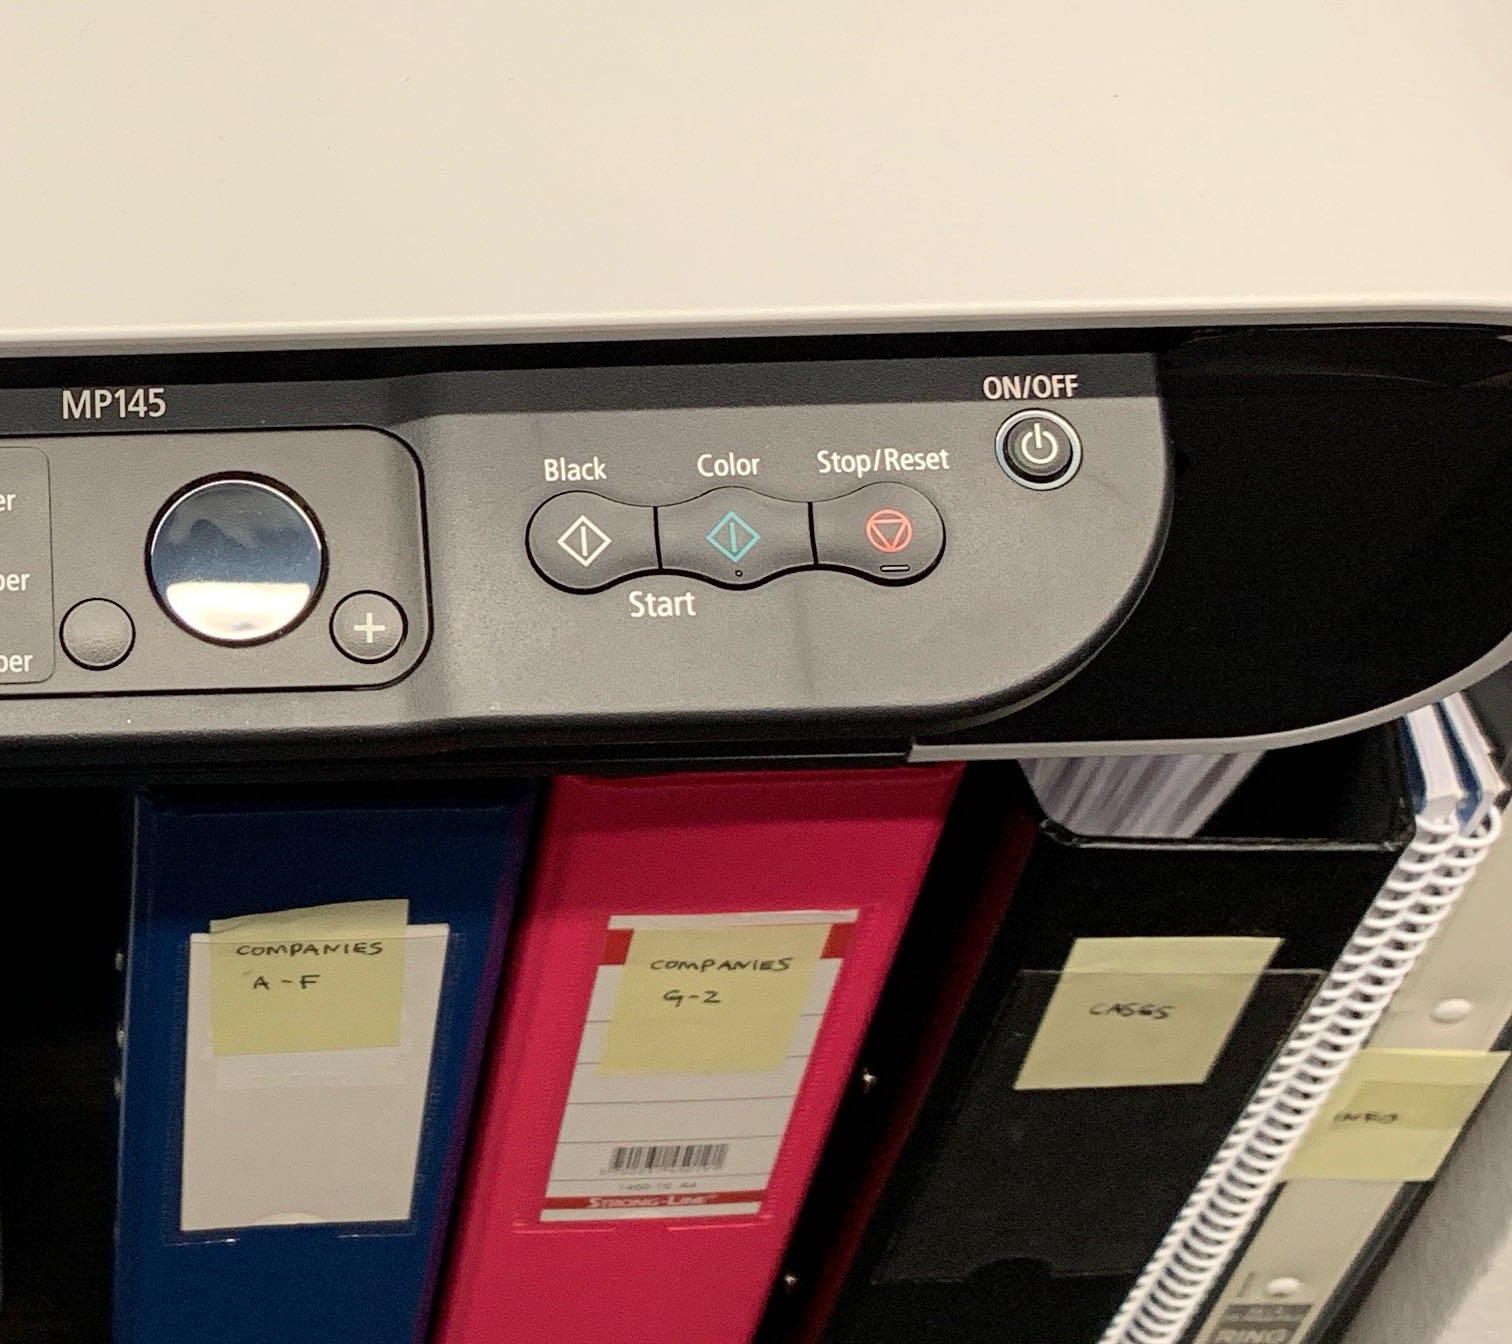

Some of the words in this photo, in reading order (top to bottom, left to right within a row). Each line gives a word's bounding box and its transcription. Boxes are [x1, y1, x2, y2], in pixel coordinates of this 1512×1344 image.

[982, 375, 1079, 400] ON/OFF
[62, 387, 167, 420] MP145
[544, 457, 607, 481] Black
[697, 453, 761, 477] Color
[816, 448, 950, 474] Stop/Reset
[628, 591, 697, 618] Start
[236, 941, 384, 957] COMPANIES
[650, 957, 793, 973] COMPANIES
[1214, 1328, 1290, 1344] RING
